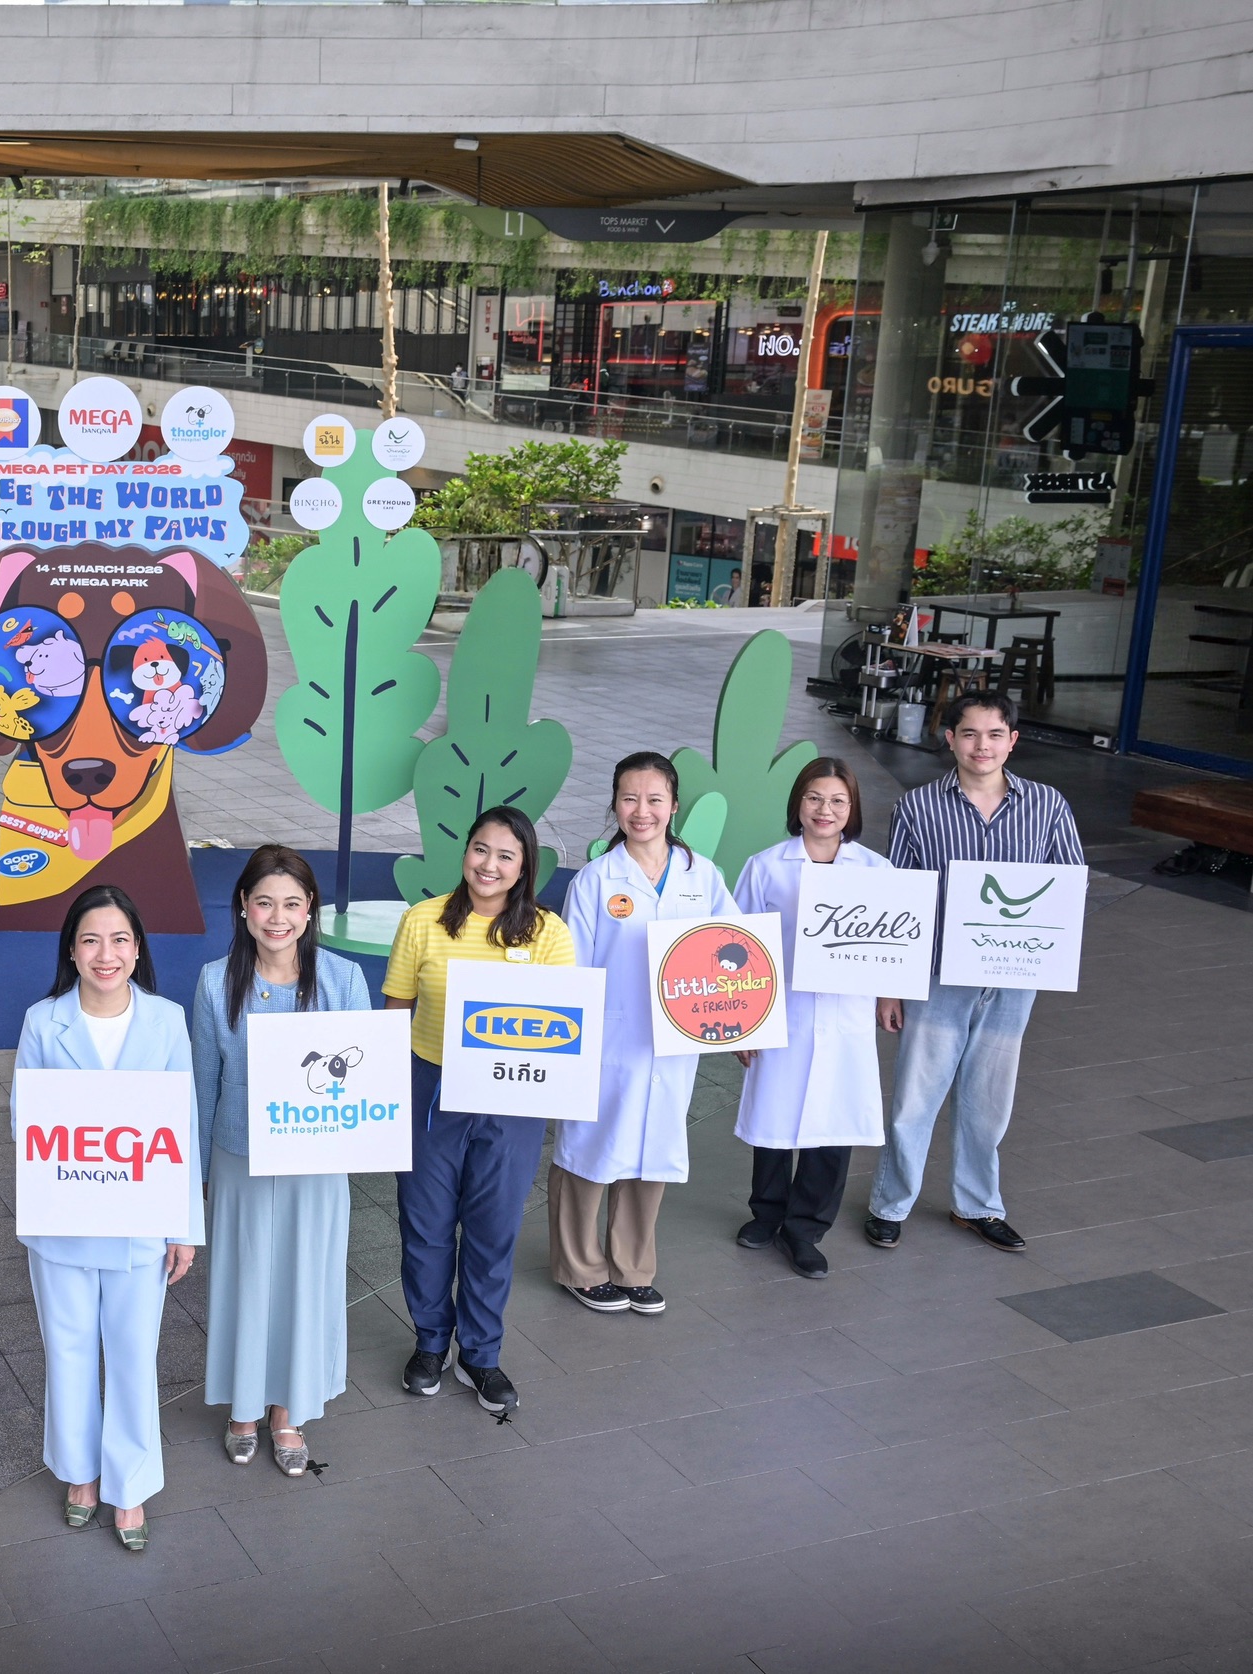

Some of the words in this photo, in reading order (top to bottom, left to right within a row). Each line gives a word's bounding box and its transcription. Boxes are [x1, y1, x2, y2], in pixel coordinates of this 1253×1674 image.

[600, 216, 618, 226] TOPS
[619, 217, 649, 227] MARKET
[950, 312, 1001, 333] STEAK
[69, 409, 133, 434] MEGA
[170, 427, 227, 441] thonglor
[318, 430, 341, 445] ฉัน
[54, 464, 89, 475] PET
[92, 464, 129, 475] DAY
[131, 464, 182, 475] 2026
[47, 484, 104, 511] THE
[116, 481, 224, 510] WORLD
[95, 518, 135, 540] MY
[144, 515, 228, 542] PAWS
[35, 564, 50, 573] 14
[57, 564, 72, 573] 15
[73, 564, 125, 574] MARCH
[126, 565, 164, 575] 2026
[50, 577, 65, 587] AT
[65, 578, 112, 587] MEGA
[114, 578, 149, 588] PARK
[0, 813, 27, 829] BEST
[26, 822, 62, 842] BUDDY
[2, 852, 39, 866] GOOD
[803, 903, 921, 940] Kiehl's
[829, 952, 868, 962] SINCE
[875, 955, 904, 964] 1851
[980, 955, 1010, 963] BAAN
[1015, 957, 1042, 965] YING
[691, 1003, 700, 1014] &
[702, 998, 749, 1014] FRIENDS
[492, 1062, 547, 1083] อิเกีย
[265, 1098, 400, 1130] thonglor
[269, 1126, 288, 1135] Pet
[291, 1124, 340, 1136] Hospital
[25, 1124, 184, 1182] MEGA
